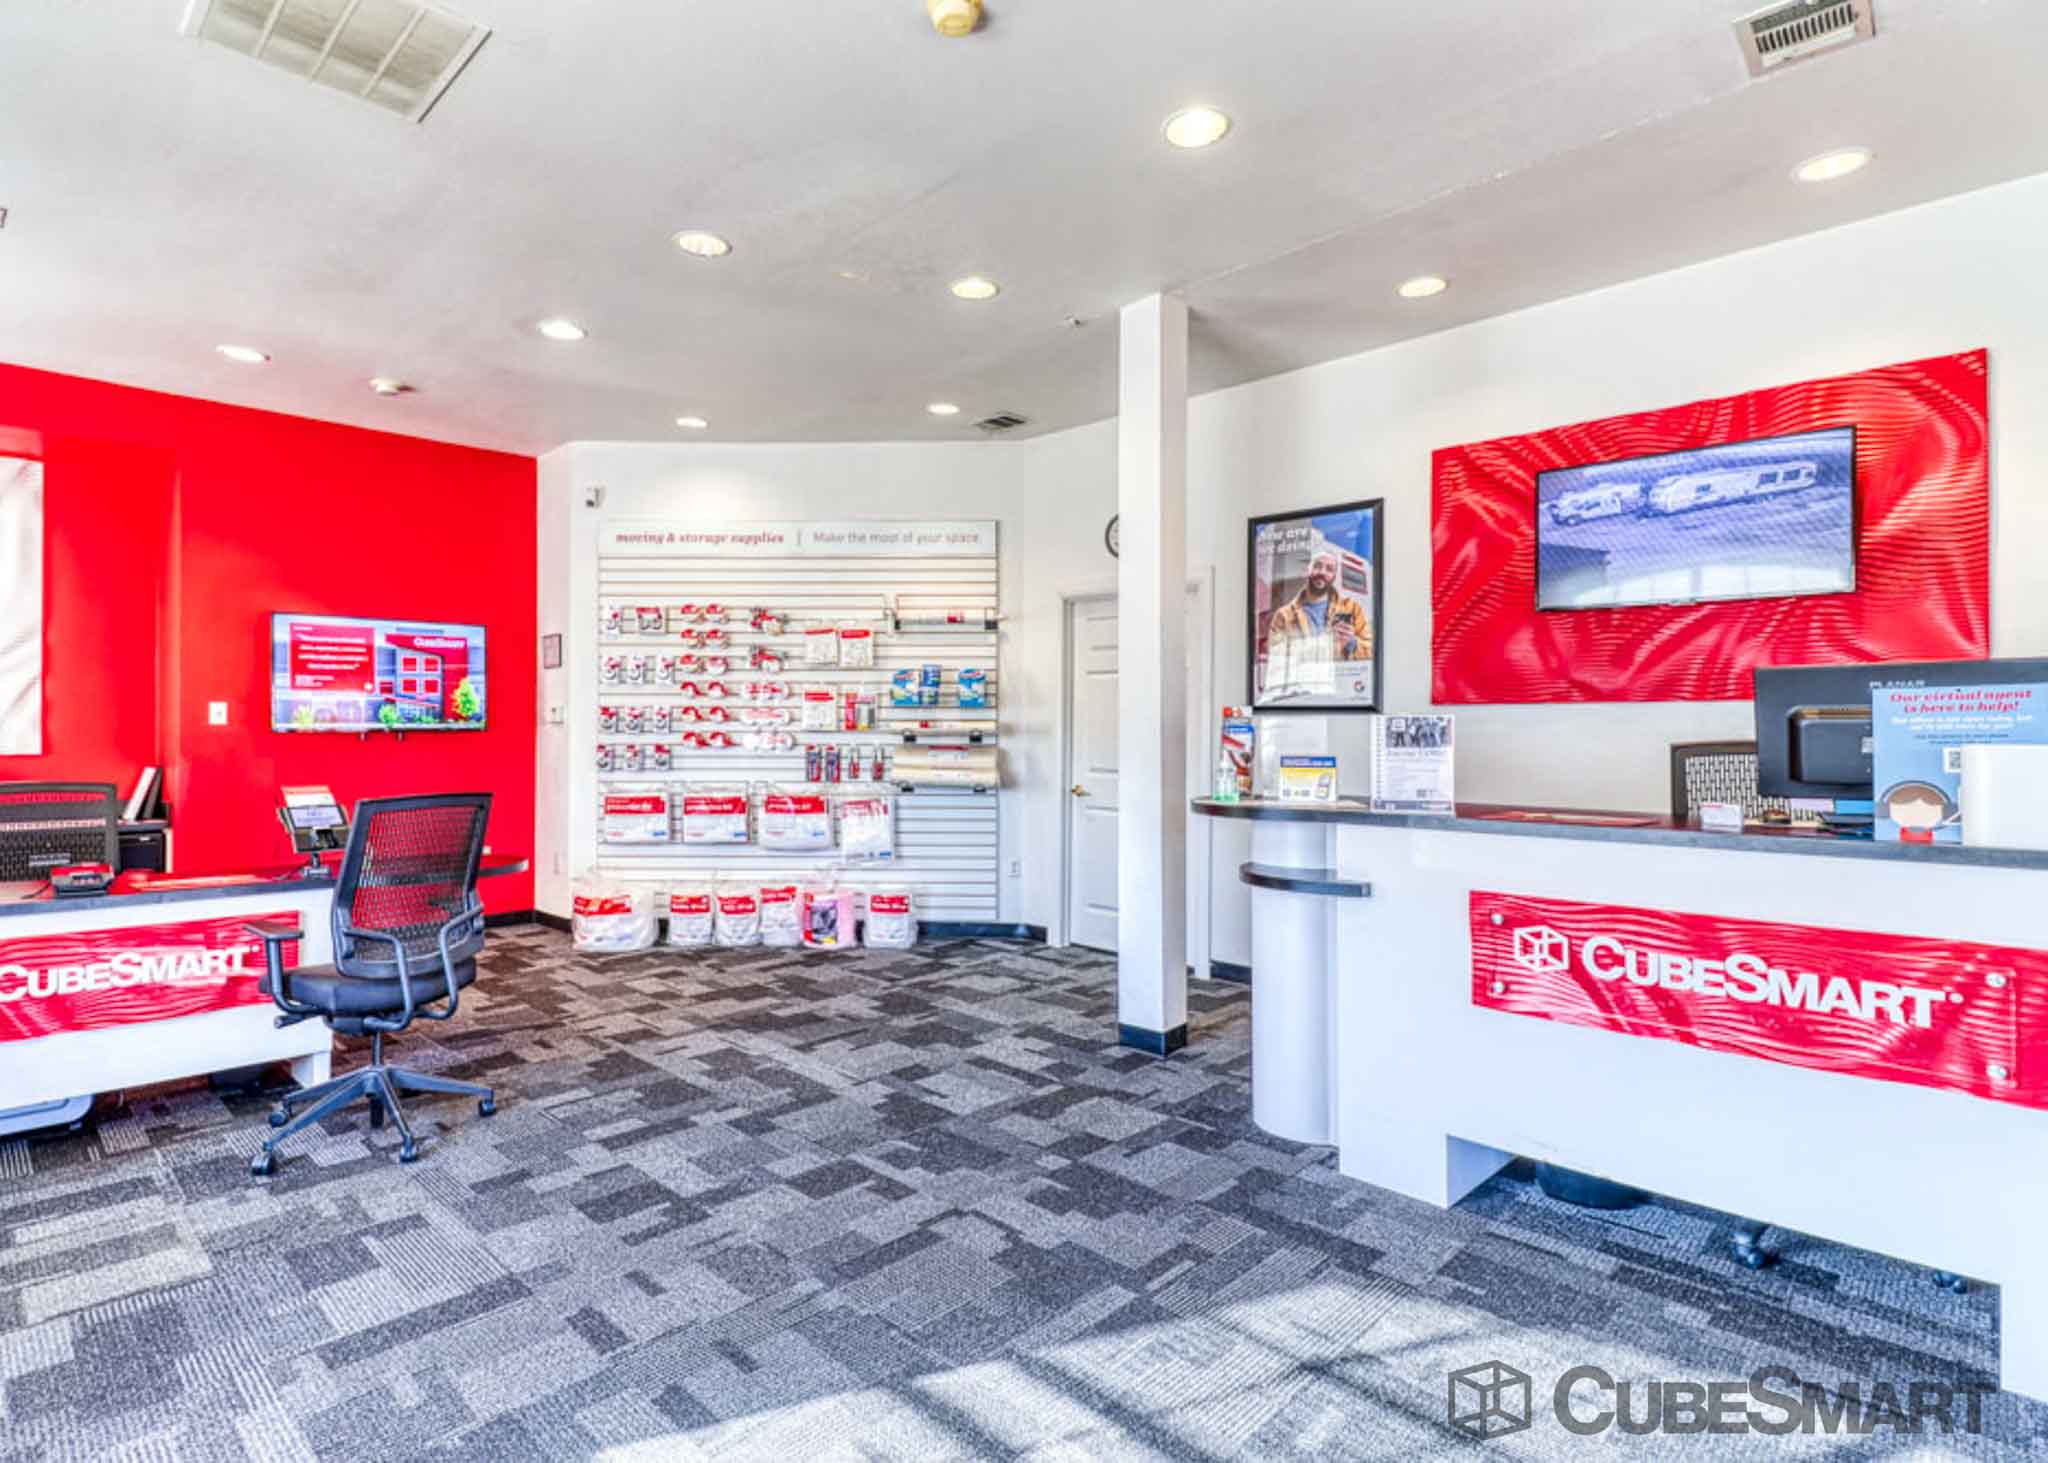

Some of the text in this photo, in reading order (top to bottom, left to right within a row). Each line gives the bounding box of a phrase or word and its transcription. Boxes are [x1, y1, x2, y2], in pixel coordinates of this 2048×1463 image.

[615, 530, 785, 545] moving & storage supplies
[813, 530, 979, 545] Make the most of your space
[1890, 689, 2032, 702] Our virtual agent
[1904, 701, 2020, 713] is here to help!
